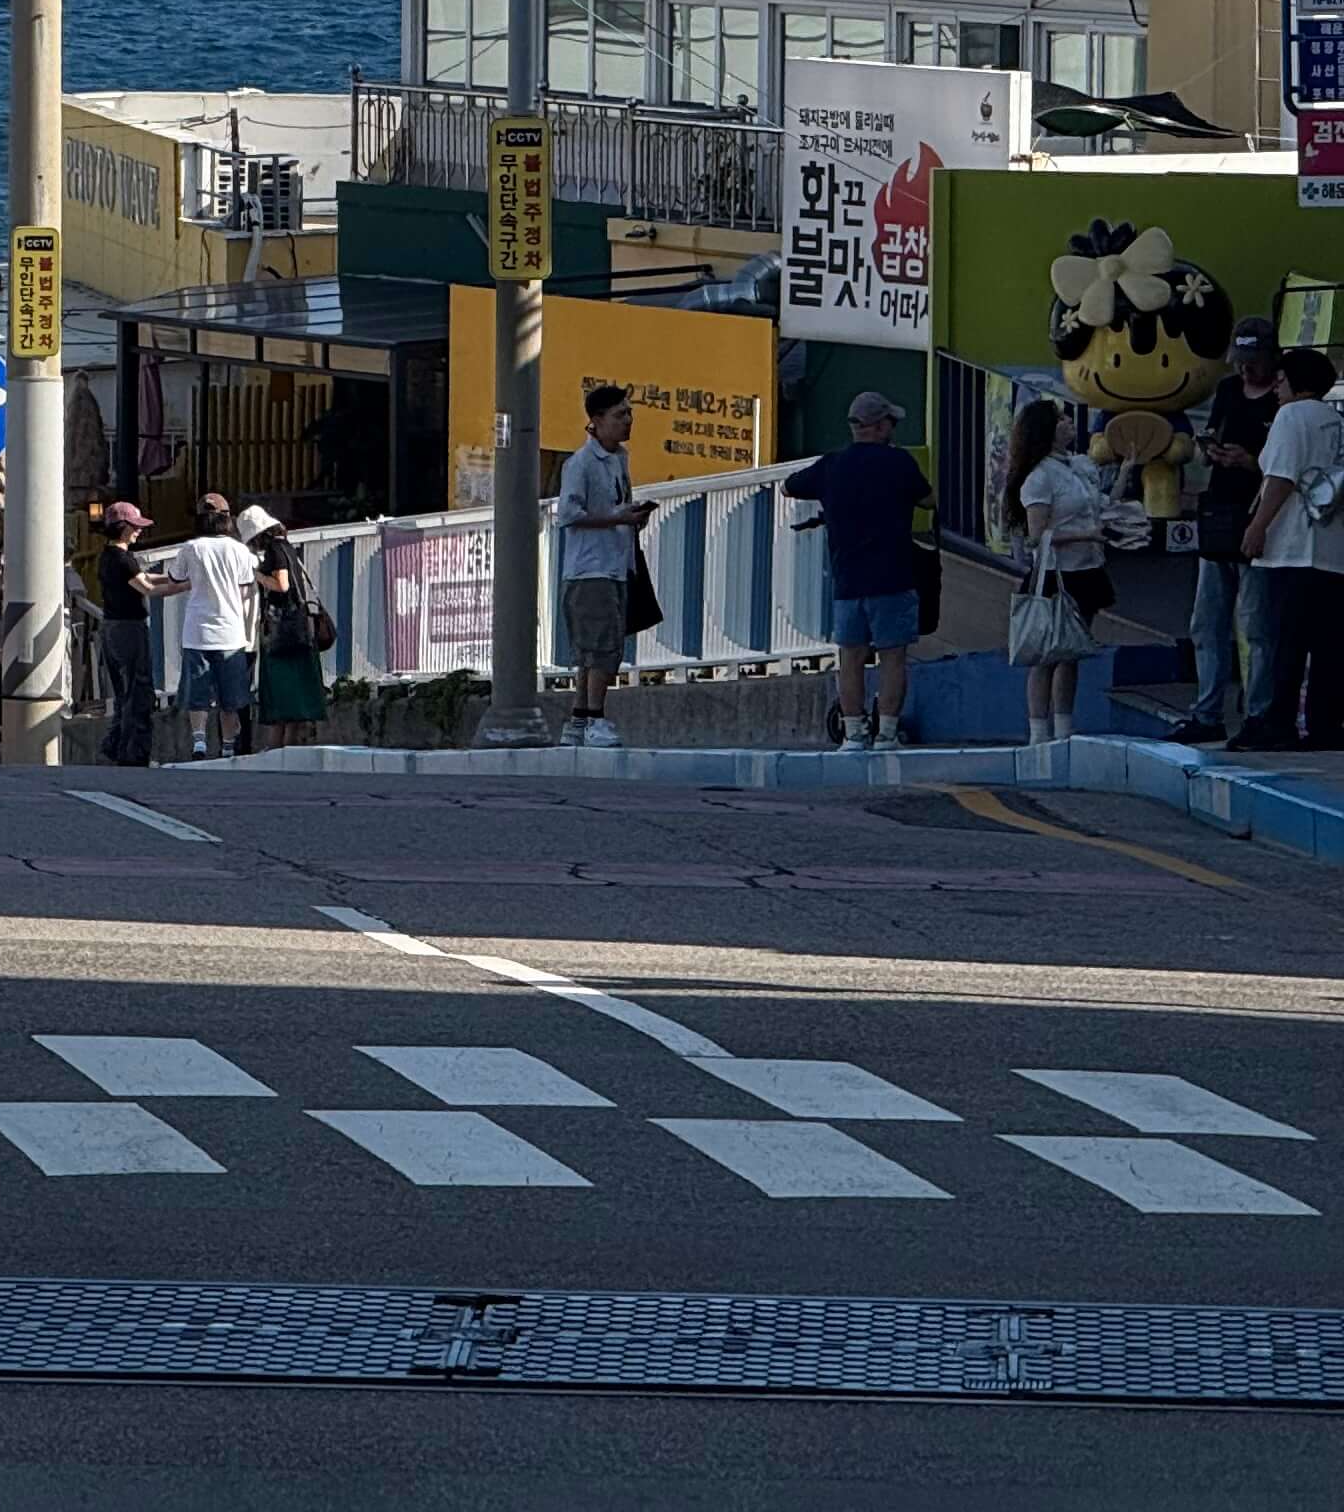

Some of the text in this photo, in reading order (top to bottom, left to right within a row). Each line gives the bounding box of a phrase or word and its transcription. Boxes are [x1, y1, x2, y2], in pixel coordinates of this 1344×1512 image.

[64, 136, 116, 213] PHOTO
[507, 132, 541, 144] CCTV
[499, 154, 518, 270] 무인단속구간
[523, 153, 542, 270] 불법주정차
[799, 161, 866, 233] 화끈
[25, 239, 53, 249] CCTV
[787, 226, 871, 309] 불맛!
[880, 223, 928, 278] 곱창
[19, 257, 34, 349] 무인단속구간
[38, 257, 54, 349] 불법주정차
